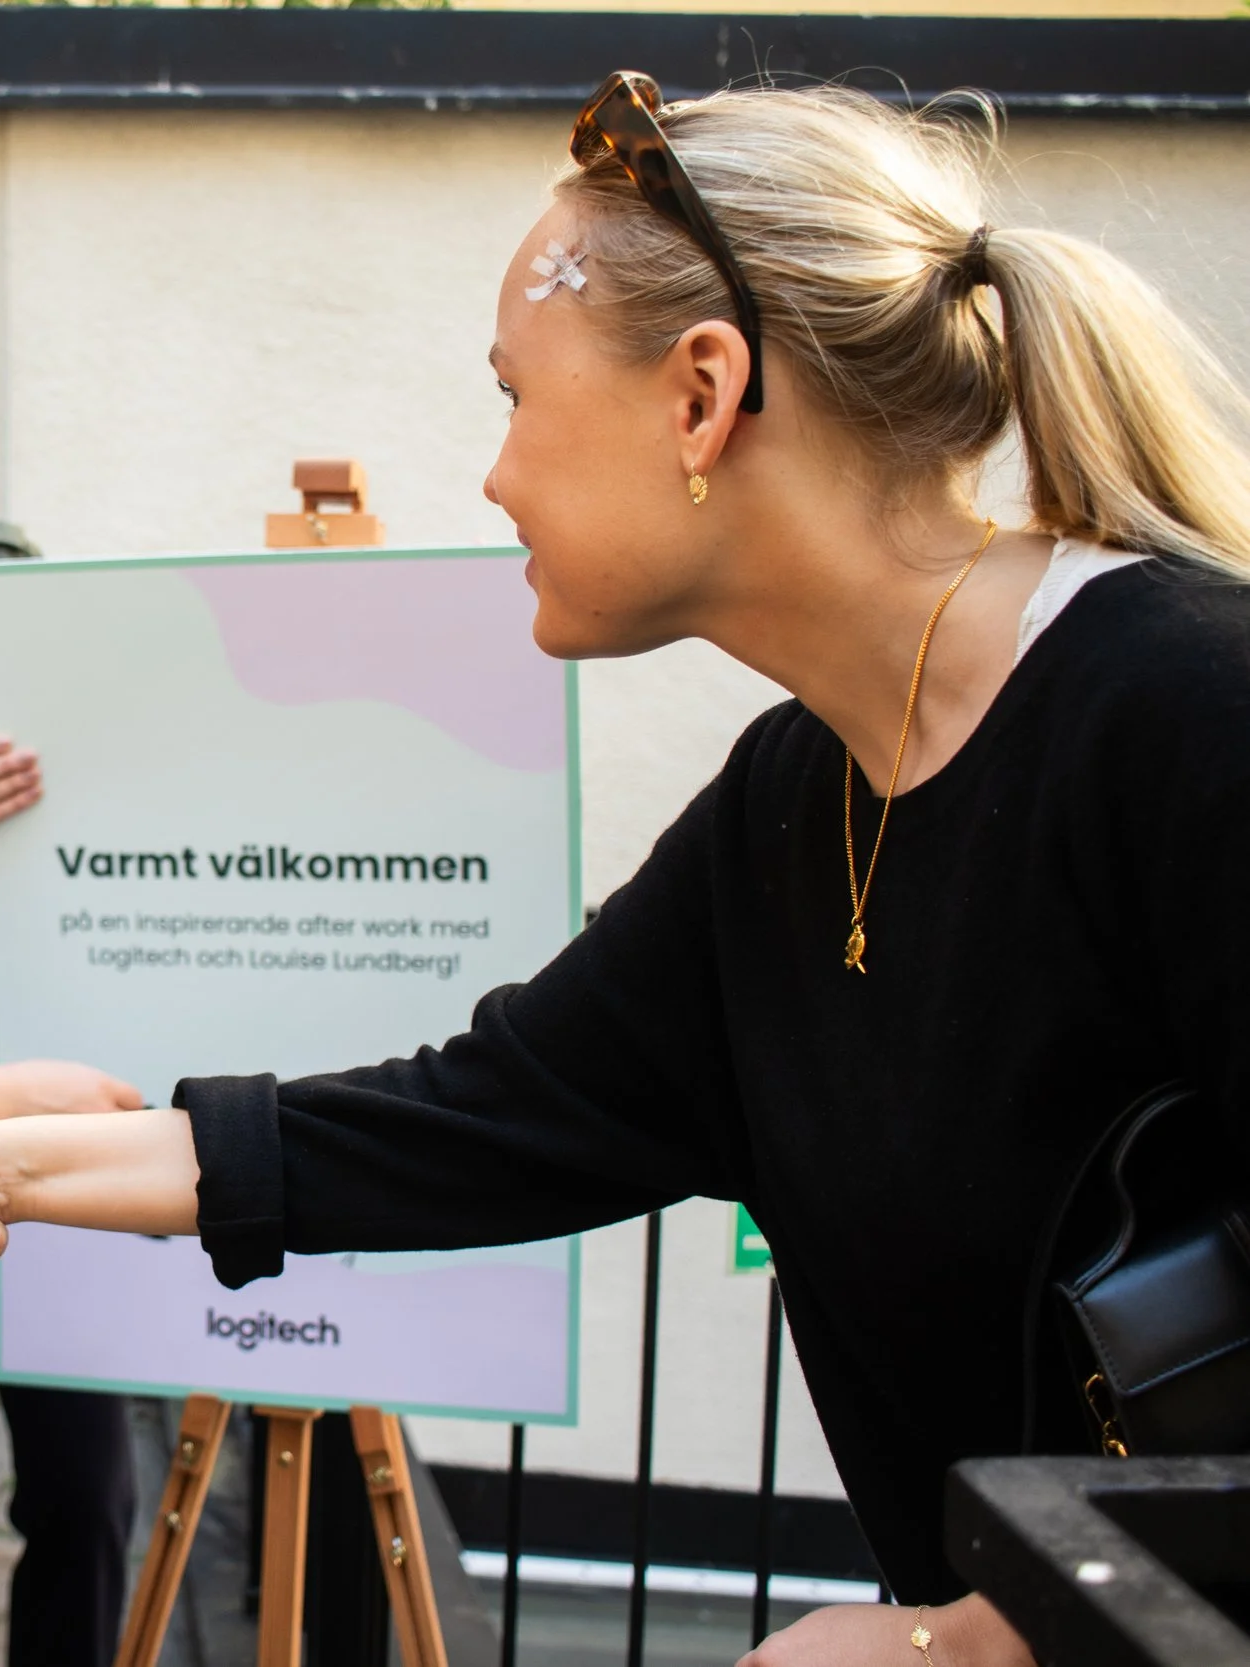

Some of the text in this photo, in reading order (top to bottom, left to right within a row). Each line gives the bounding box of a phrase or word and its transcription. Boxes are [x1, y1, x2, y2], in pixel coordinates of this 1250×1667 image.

[56, 844, 489, 882] Varmt välkommen
[61, 909, 490, 940] på en inspirerande after work med
[88, 945, 461, 980] Logitech och Louise Lundberg!
[206, 1307, 341, 1350] logitech
